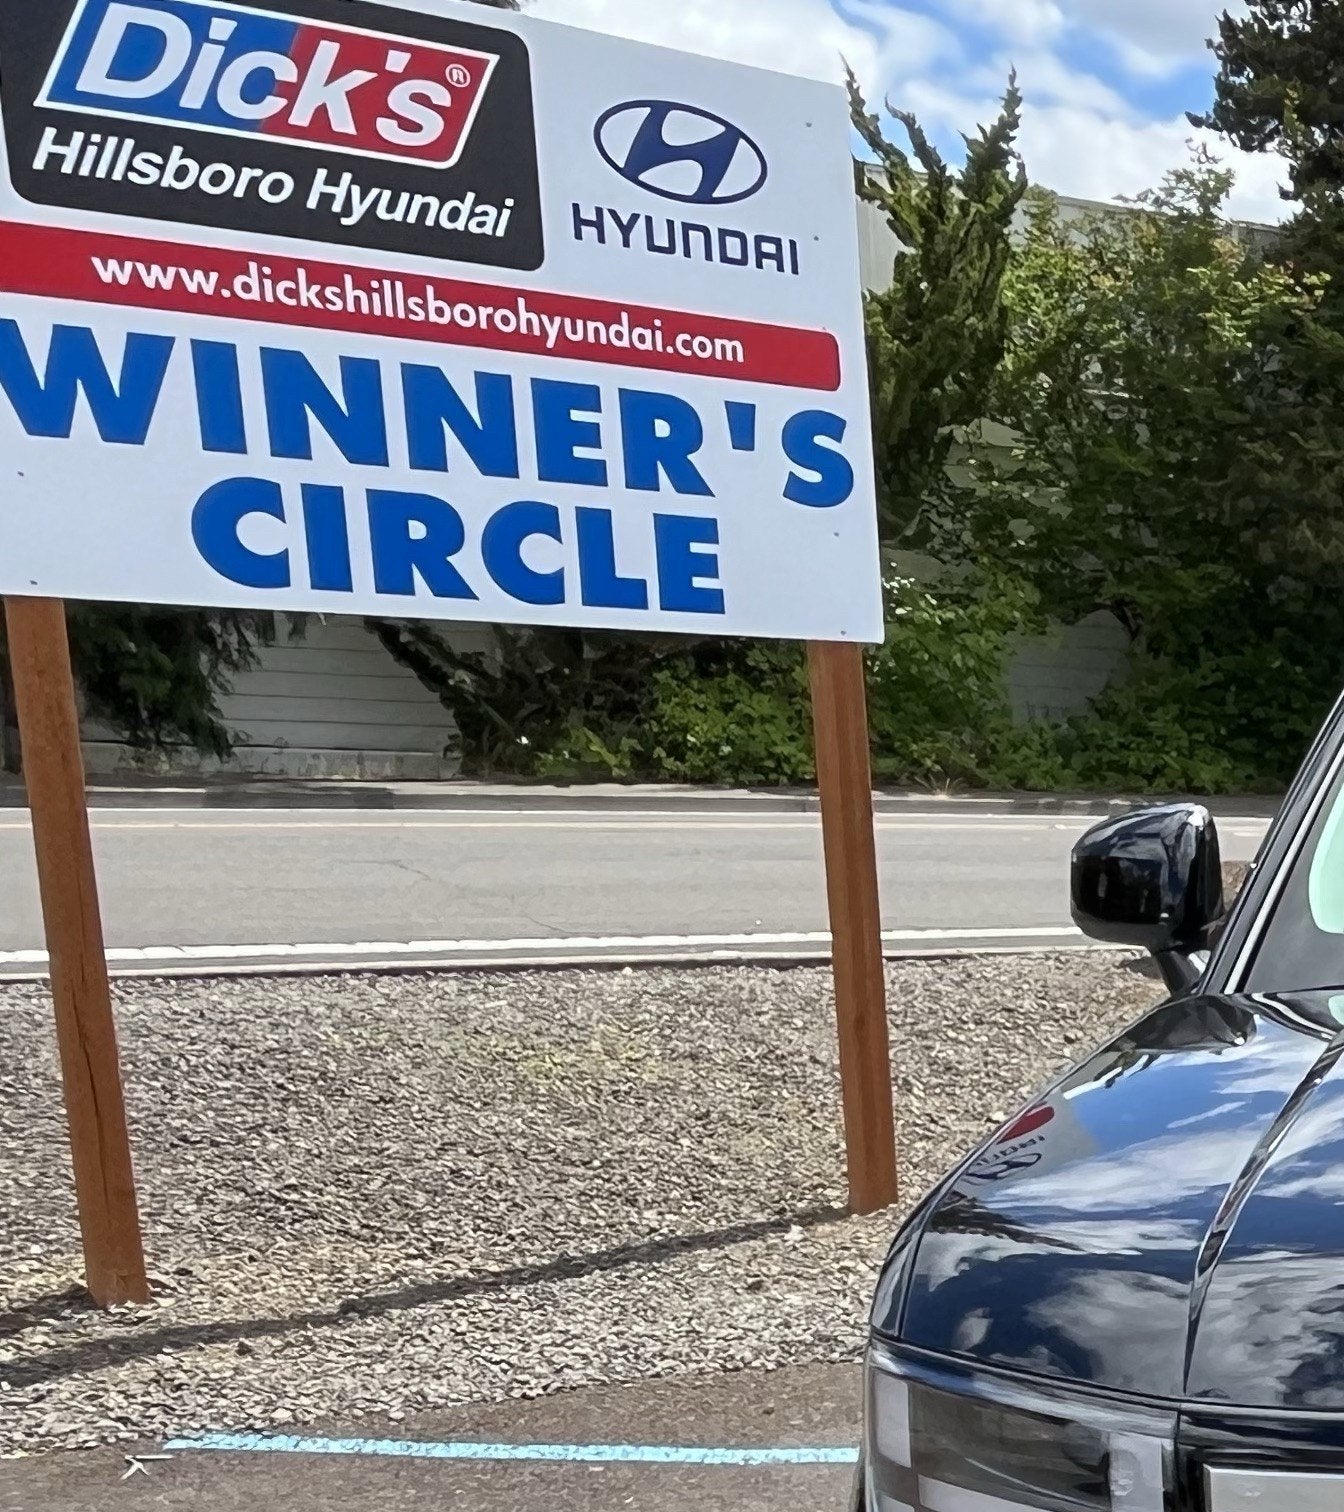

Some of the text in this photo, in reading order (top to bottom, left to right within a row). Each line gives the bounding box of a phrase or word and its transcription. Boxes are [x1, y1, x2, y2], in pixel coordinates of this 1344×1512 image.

[76, 3, 452, 146] Dick's
[32, 127, 514, 238] Hillsboro Hyundai
[572, 203, 799, 275] HYUNDAI
[91, 255, 744, 363] www.dickshillsborohyundai.com
[0, 318, 854, 508] WINNER'S
[191, 477, 725, 615] CIRCLE
